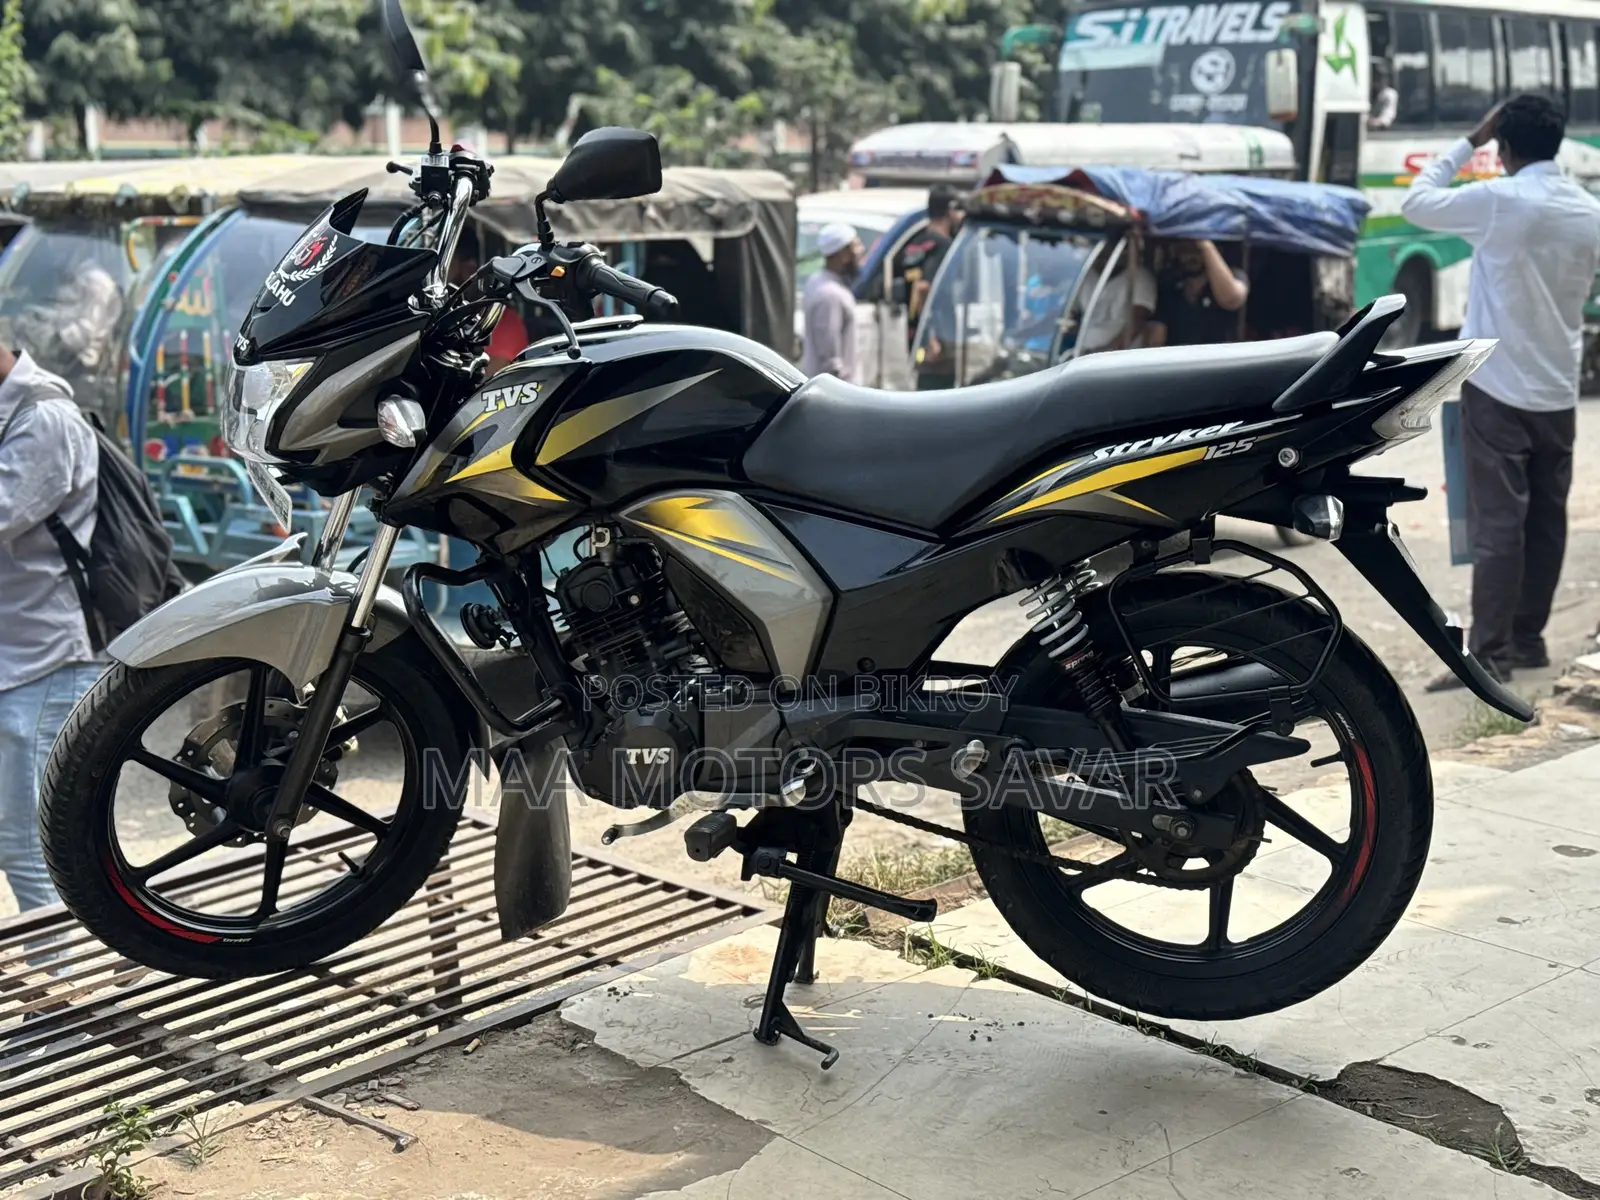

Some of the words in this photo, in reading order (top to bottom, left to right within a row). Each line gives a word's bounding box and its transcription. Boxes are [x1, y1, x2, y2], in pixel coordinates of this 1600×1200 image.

[1141, 2, 1291, 46] TRAVELS
[482, 381, 539, 412] TVS
[1088, 420, 1244, 465] Stryker
[1202, 437, 1256, 461] 125
[626, 747, 671, 765] TVS
